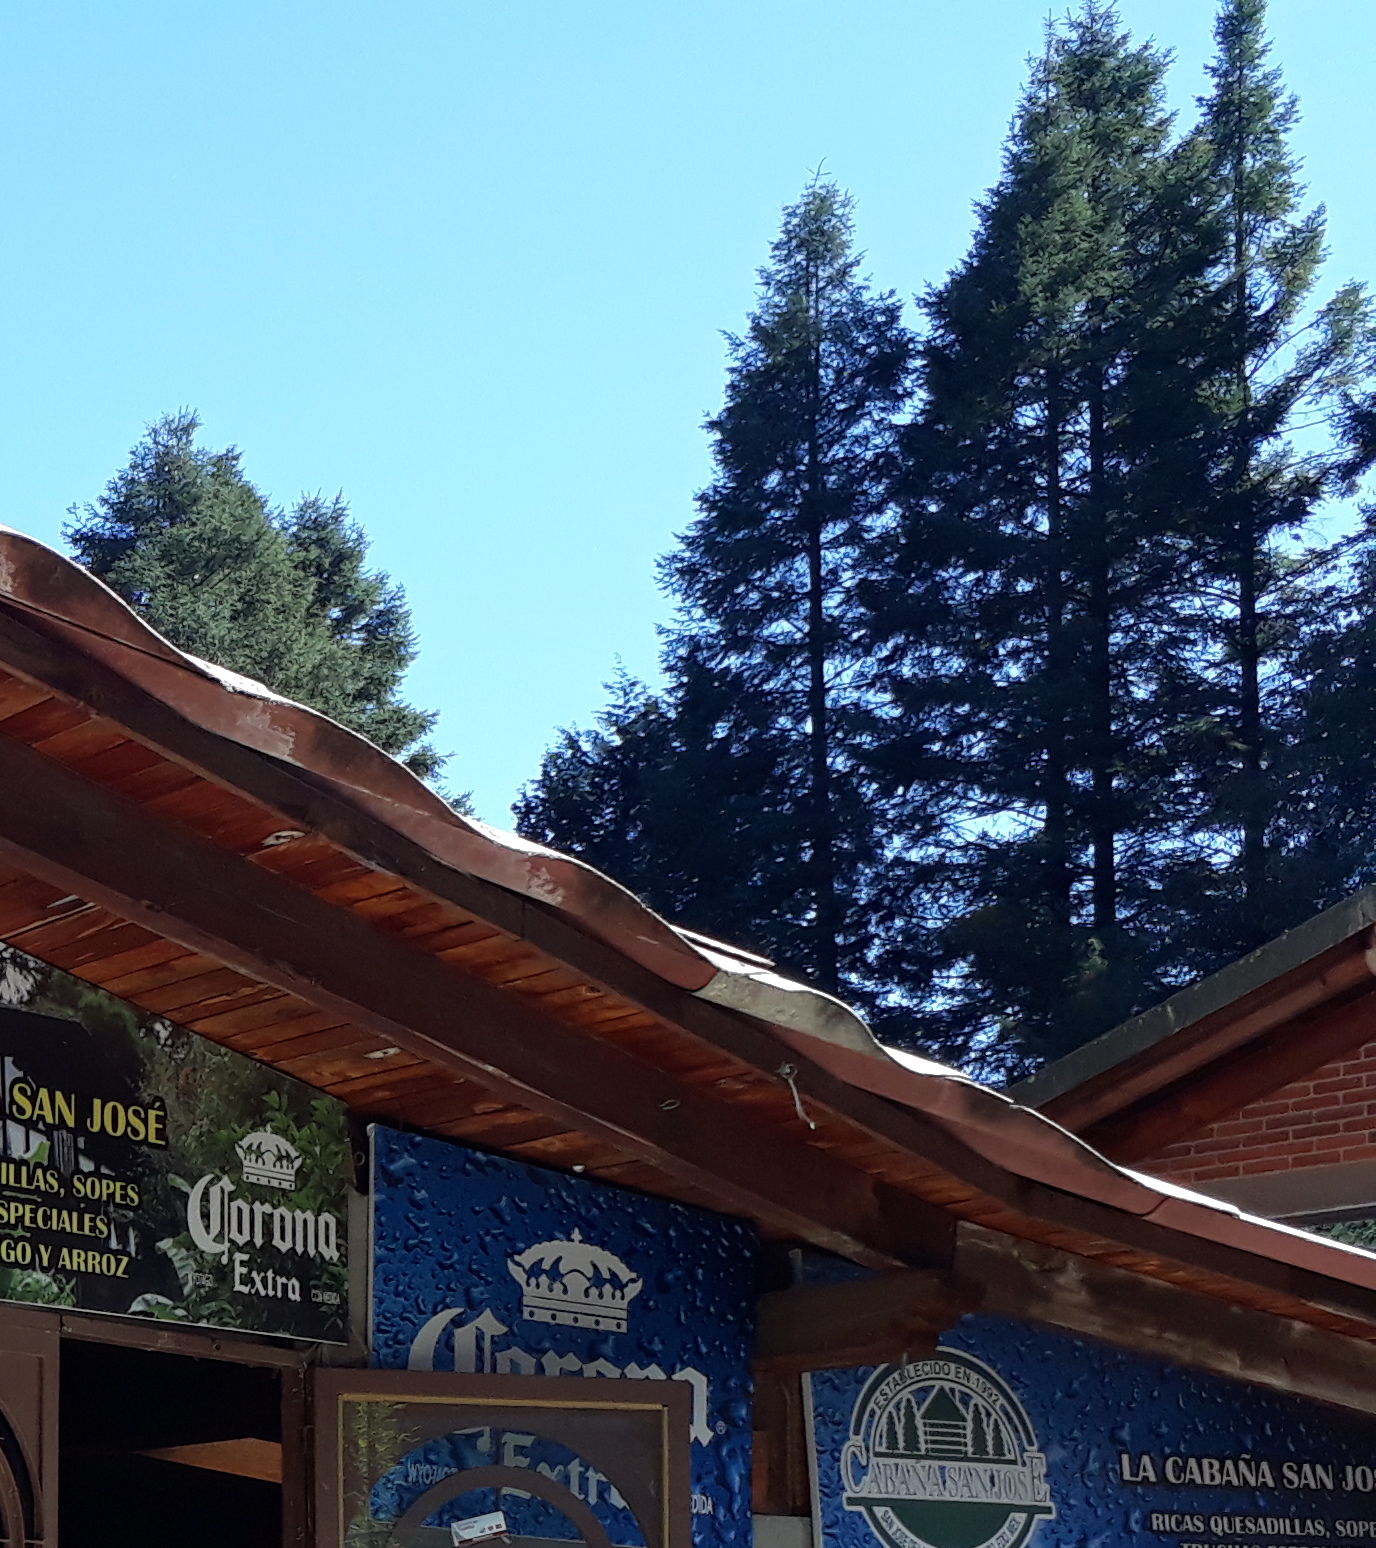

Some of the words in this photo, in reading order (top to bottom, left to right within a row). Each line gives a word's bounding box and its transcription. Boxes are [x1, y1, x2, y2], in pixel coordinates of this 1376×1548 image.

[12, 1083, 76, 1128] SAN
[86, 1098, 166, 1145] JOSÉ
[72, 1174, 139, 1207] SOPES
[187, 1174, 340, 1265] Corona
[38, 1244, 53, 1267] Y
[58, 1247, 130, 1279] ARROZ
[232, 1252, 301, 1302] Extra
[874, 1361, 951, 1411] ESTABLECIDO
[954, 1366, 971, 1384] EN
[502, 1432, 631, 1510] Etr
[1121, 1453, 1157, 1483] LA
[1165, 1454, 1275, 1488] CABAÑA
[1282, 1461, 1334, 1491] SAN
[1151, 1513, 1205, 1533] RICAS
[1210, 1515, 1331, 1539] QUESADILLAS,
[1335, 1519, 1376, 1538] SOPE
